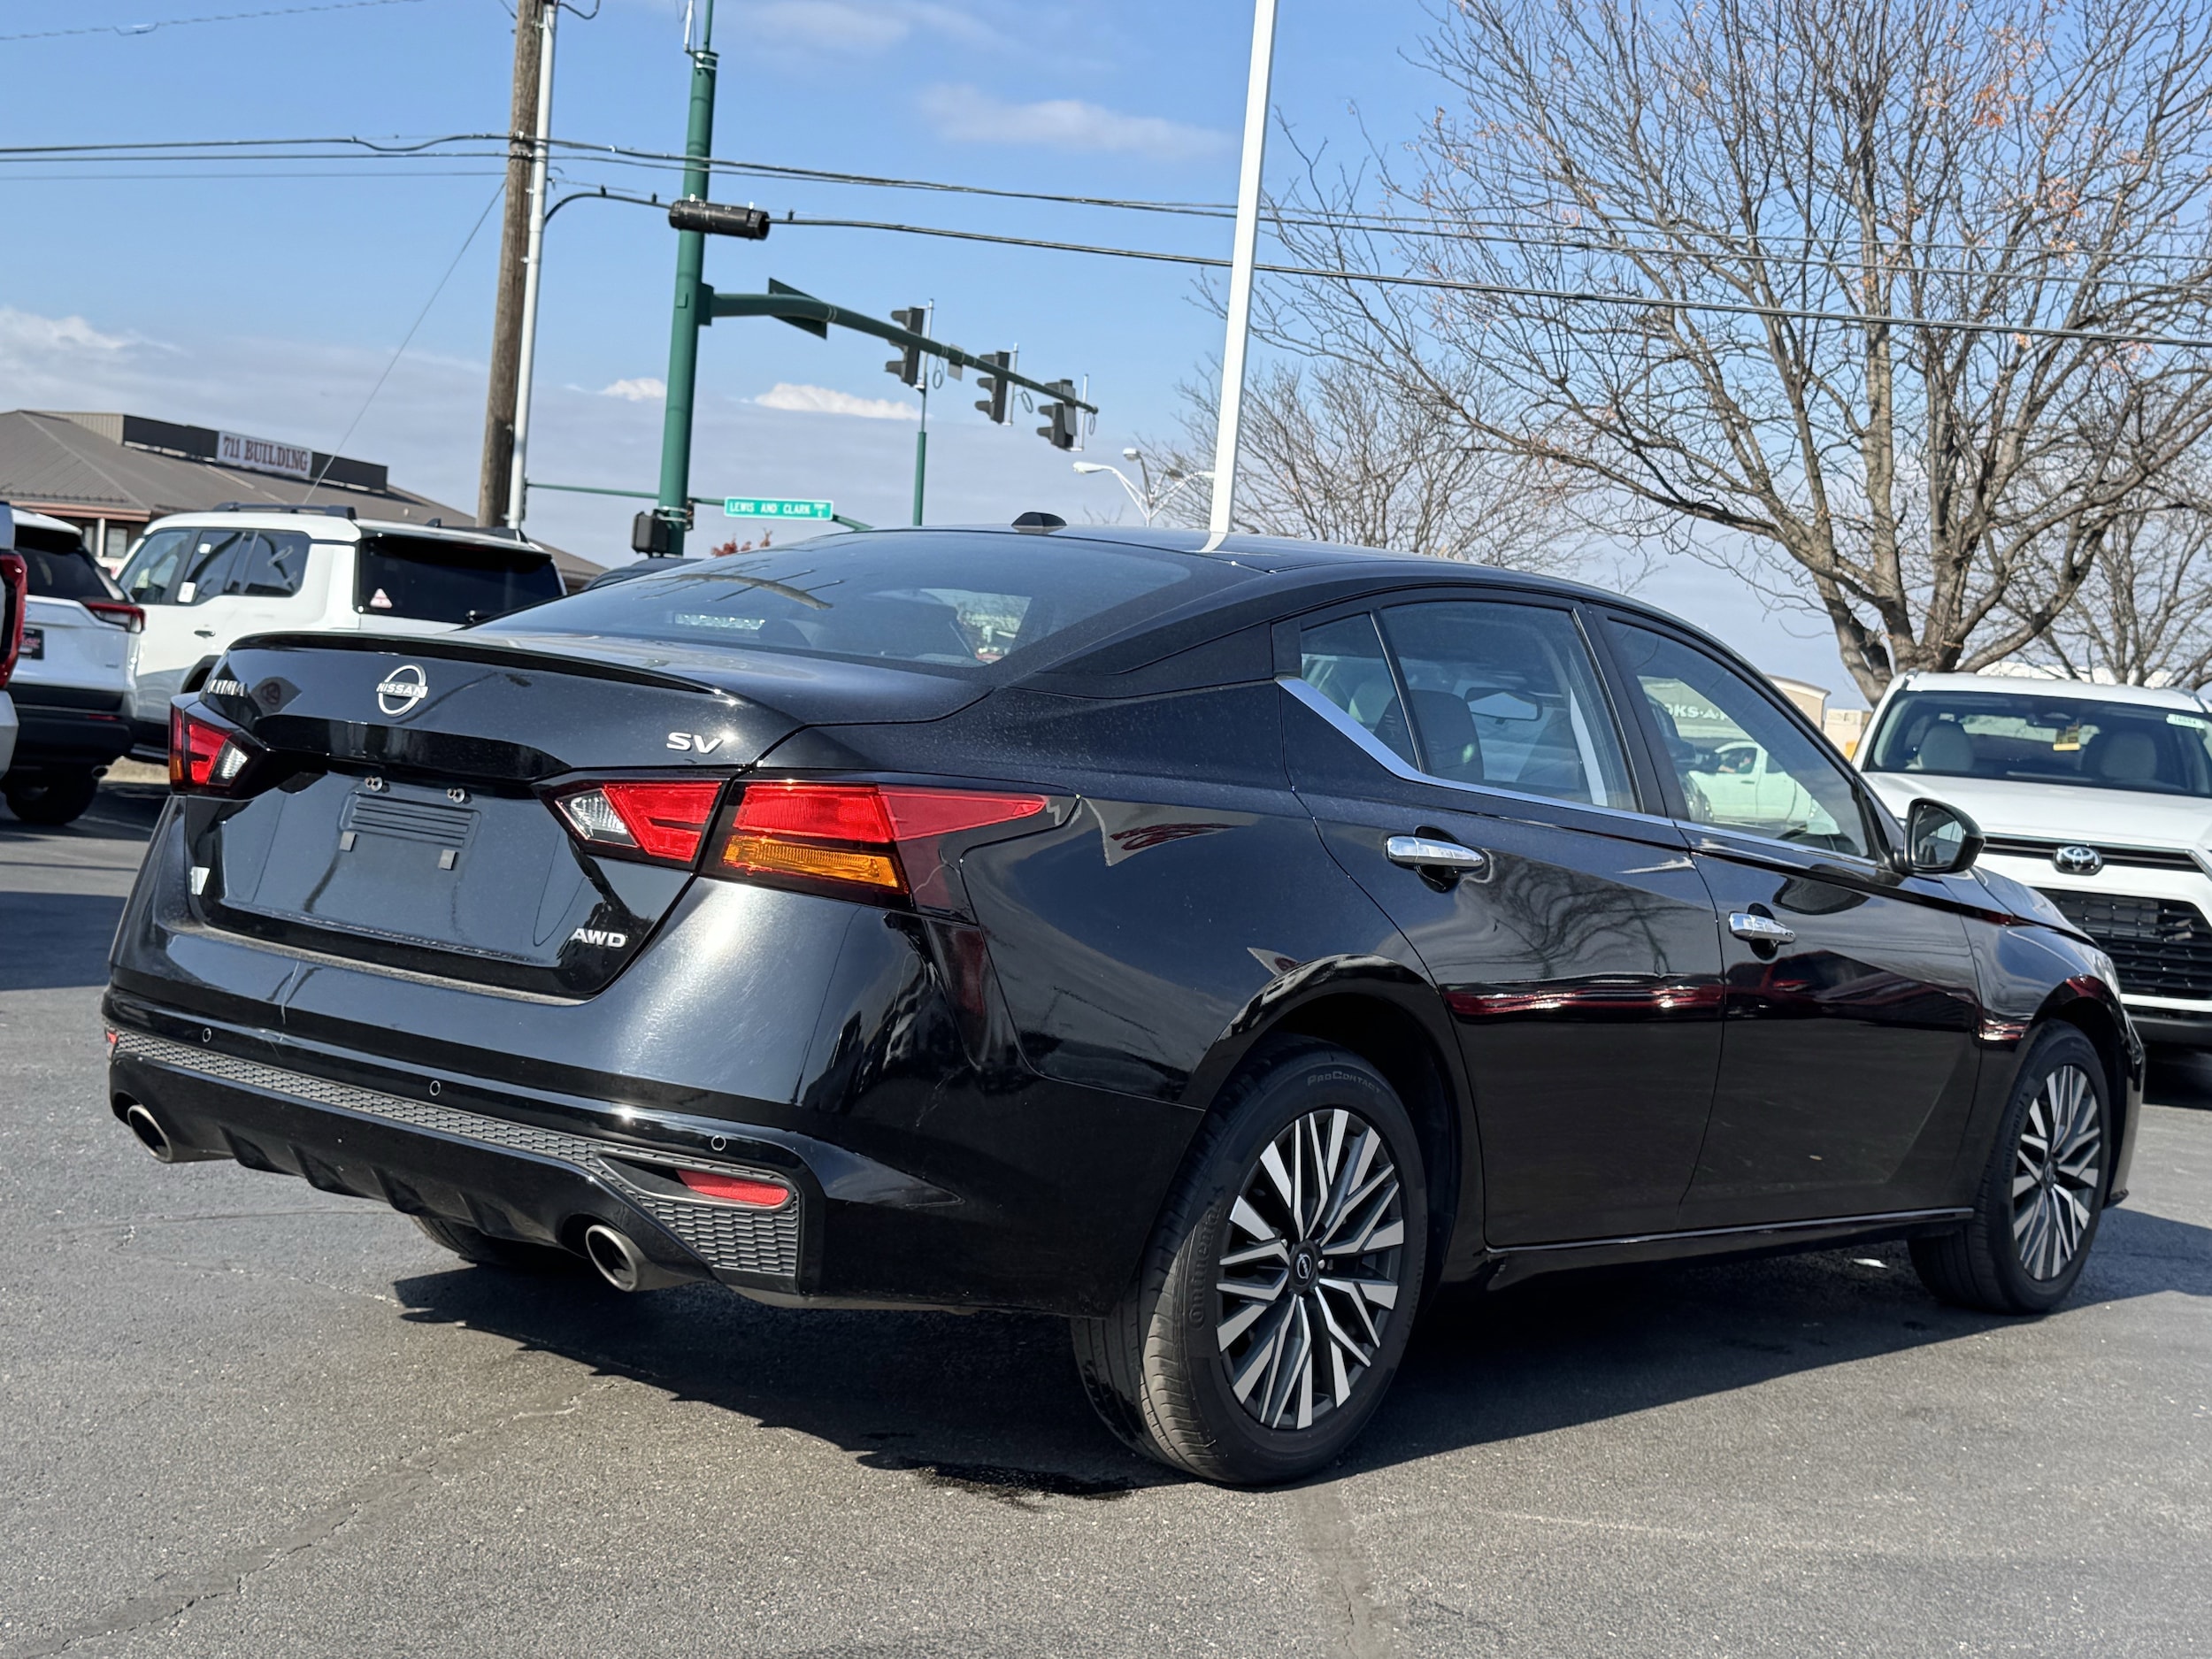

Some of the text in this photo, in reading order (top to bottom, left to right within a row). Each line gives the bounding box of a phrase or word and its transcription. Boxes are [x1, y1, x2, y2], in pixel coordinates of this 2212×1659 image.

[223, 435, 309, 472] 711 BUILDING
[729, 501, 755, 513] LEWIS
[760, 502, 778, 514] AND
[782, 503, 810, 515] CLARK
[376, 681, 428, 698] NISSAN
[665, 732, 724, 754] SV
[569, 927, 626, 949] AWD
